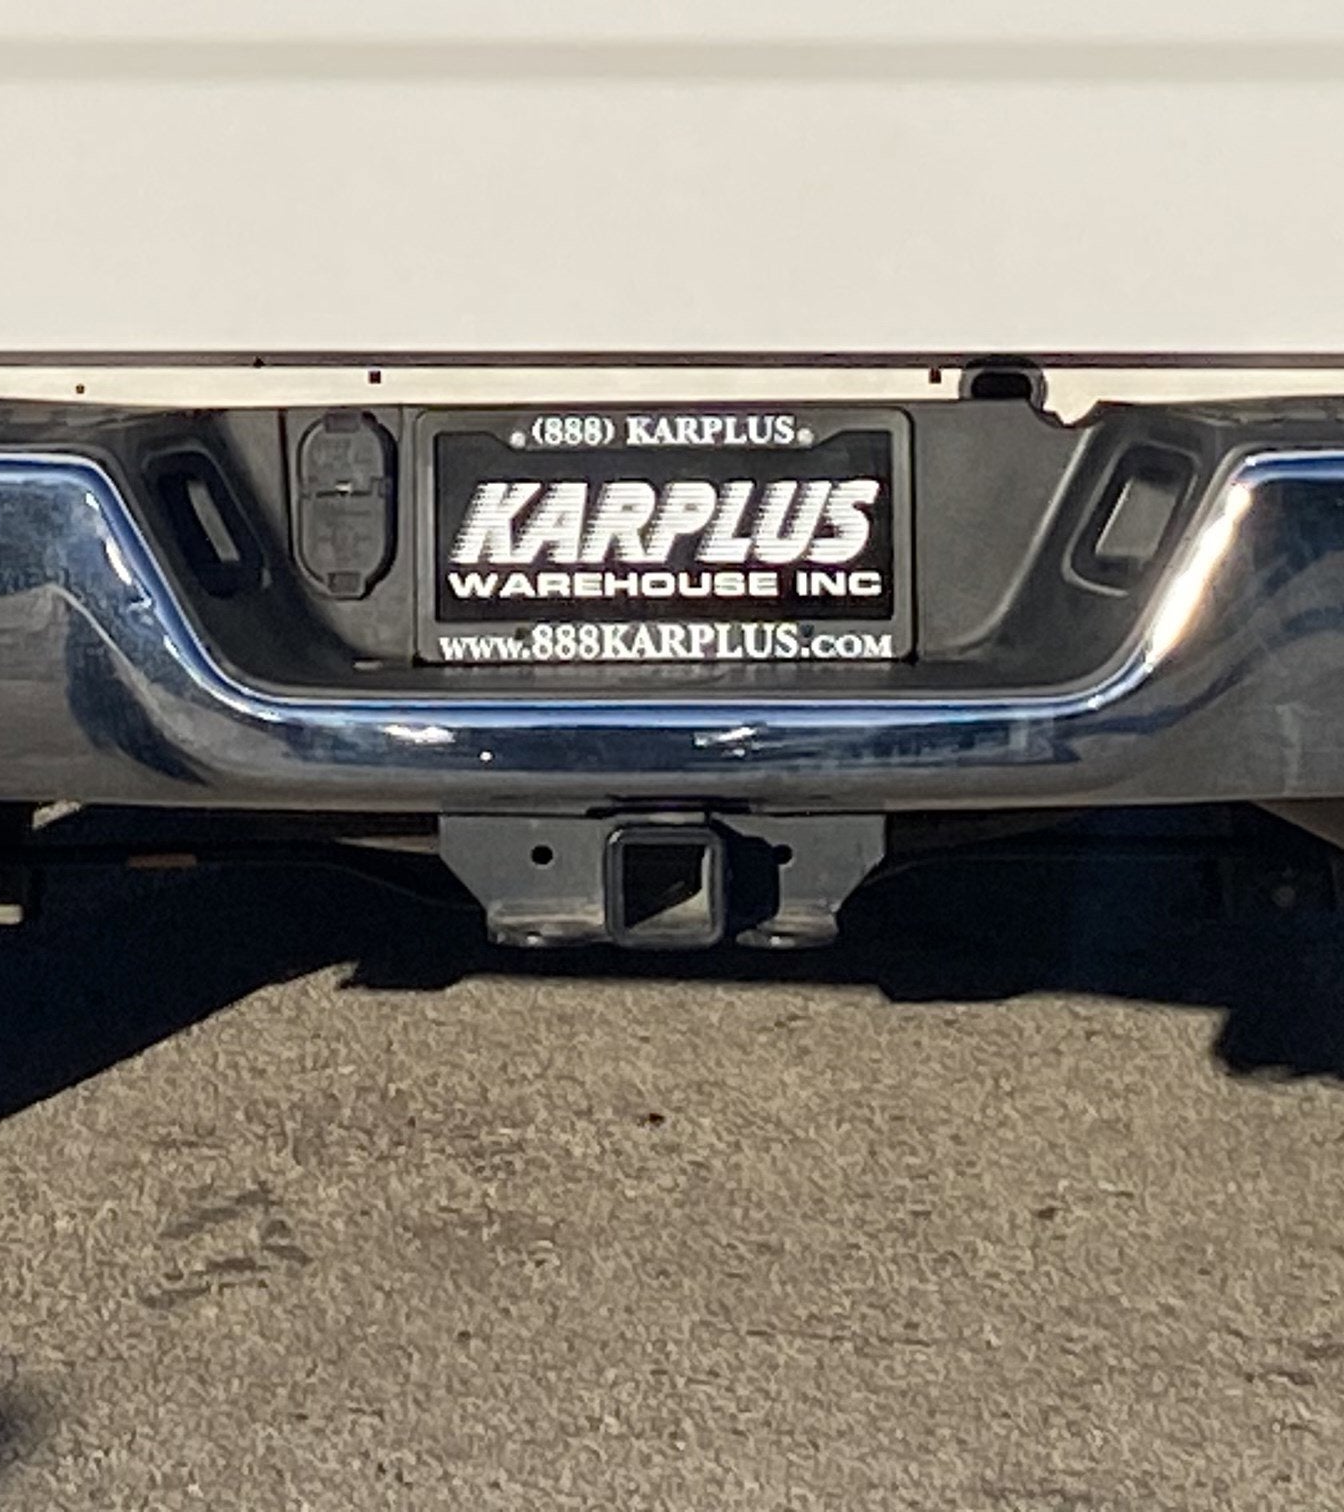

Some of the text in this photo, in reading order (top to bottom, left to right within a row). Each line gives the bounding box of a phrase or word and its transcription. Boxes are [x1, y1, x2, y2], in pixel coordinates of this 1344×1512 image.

[532, 415, 795, 446] (888) KARPLUS
[450, 479, 880, 564] KARPLUS
[449, 571, 882, 598] WAREHOUSE INC
